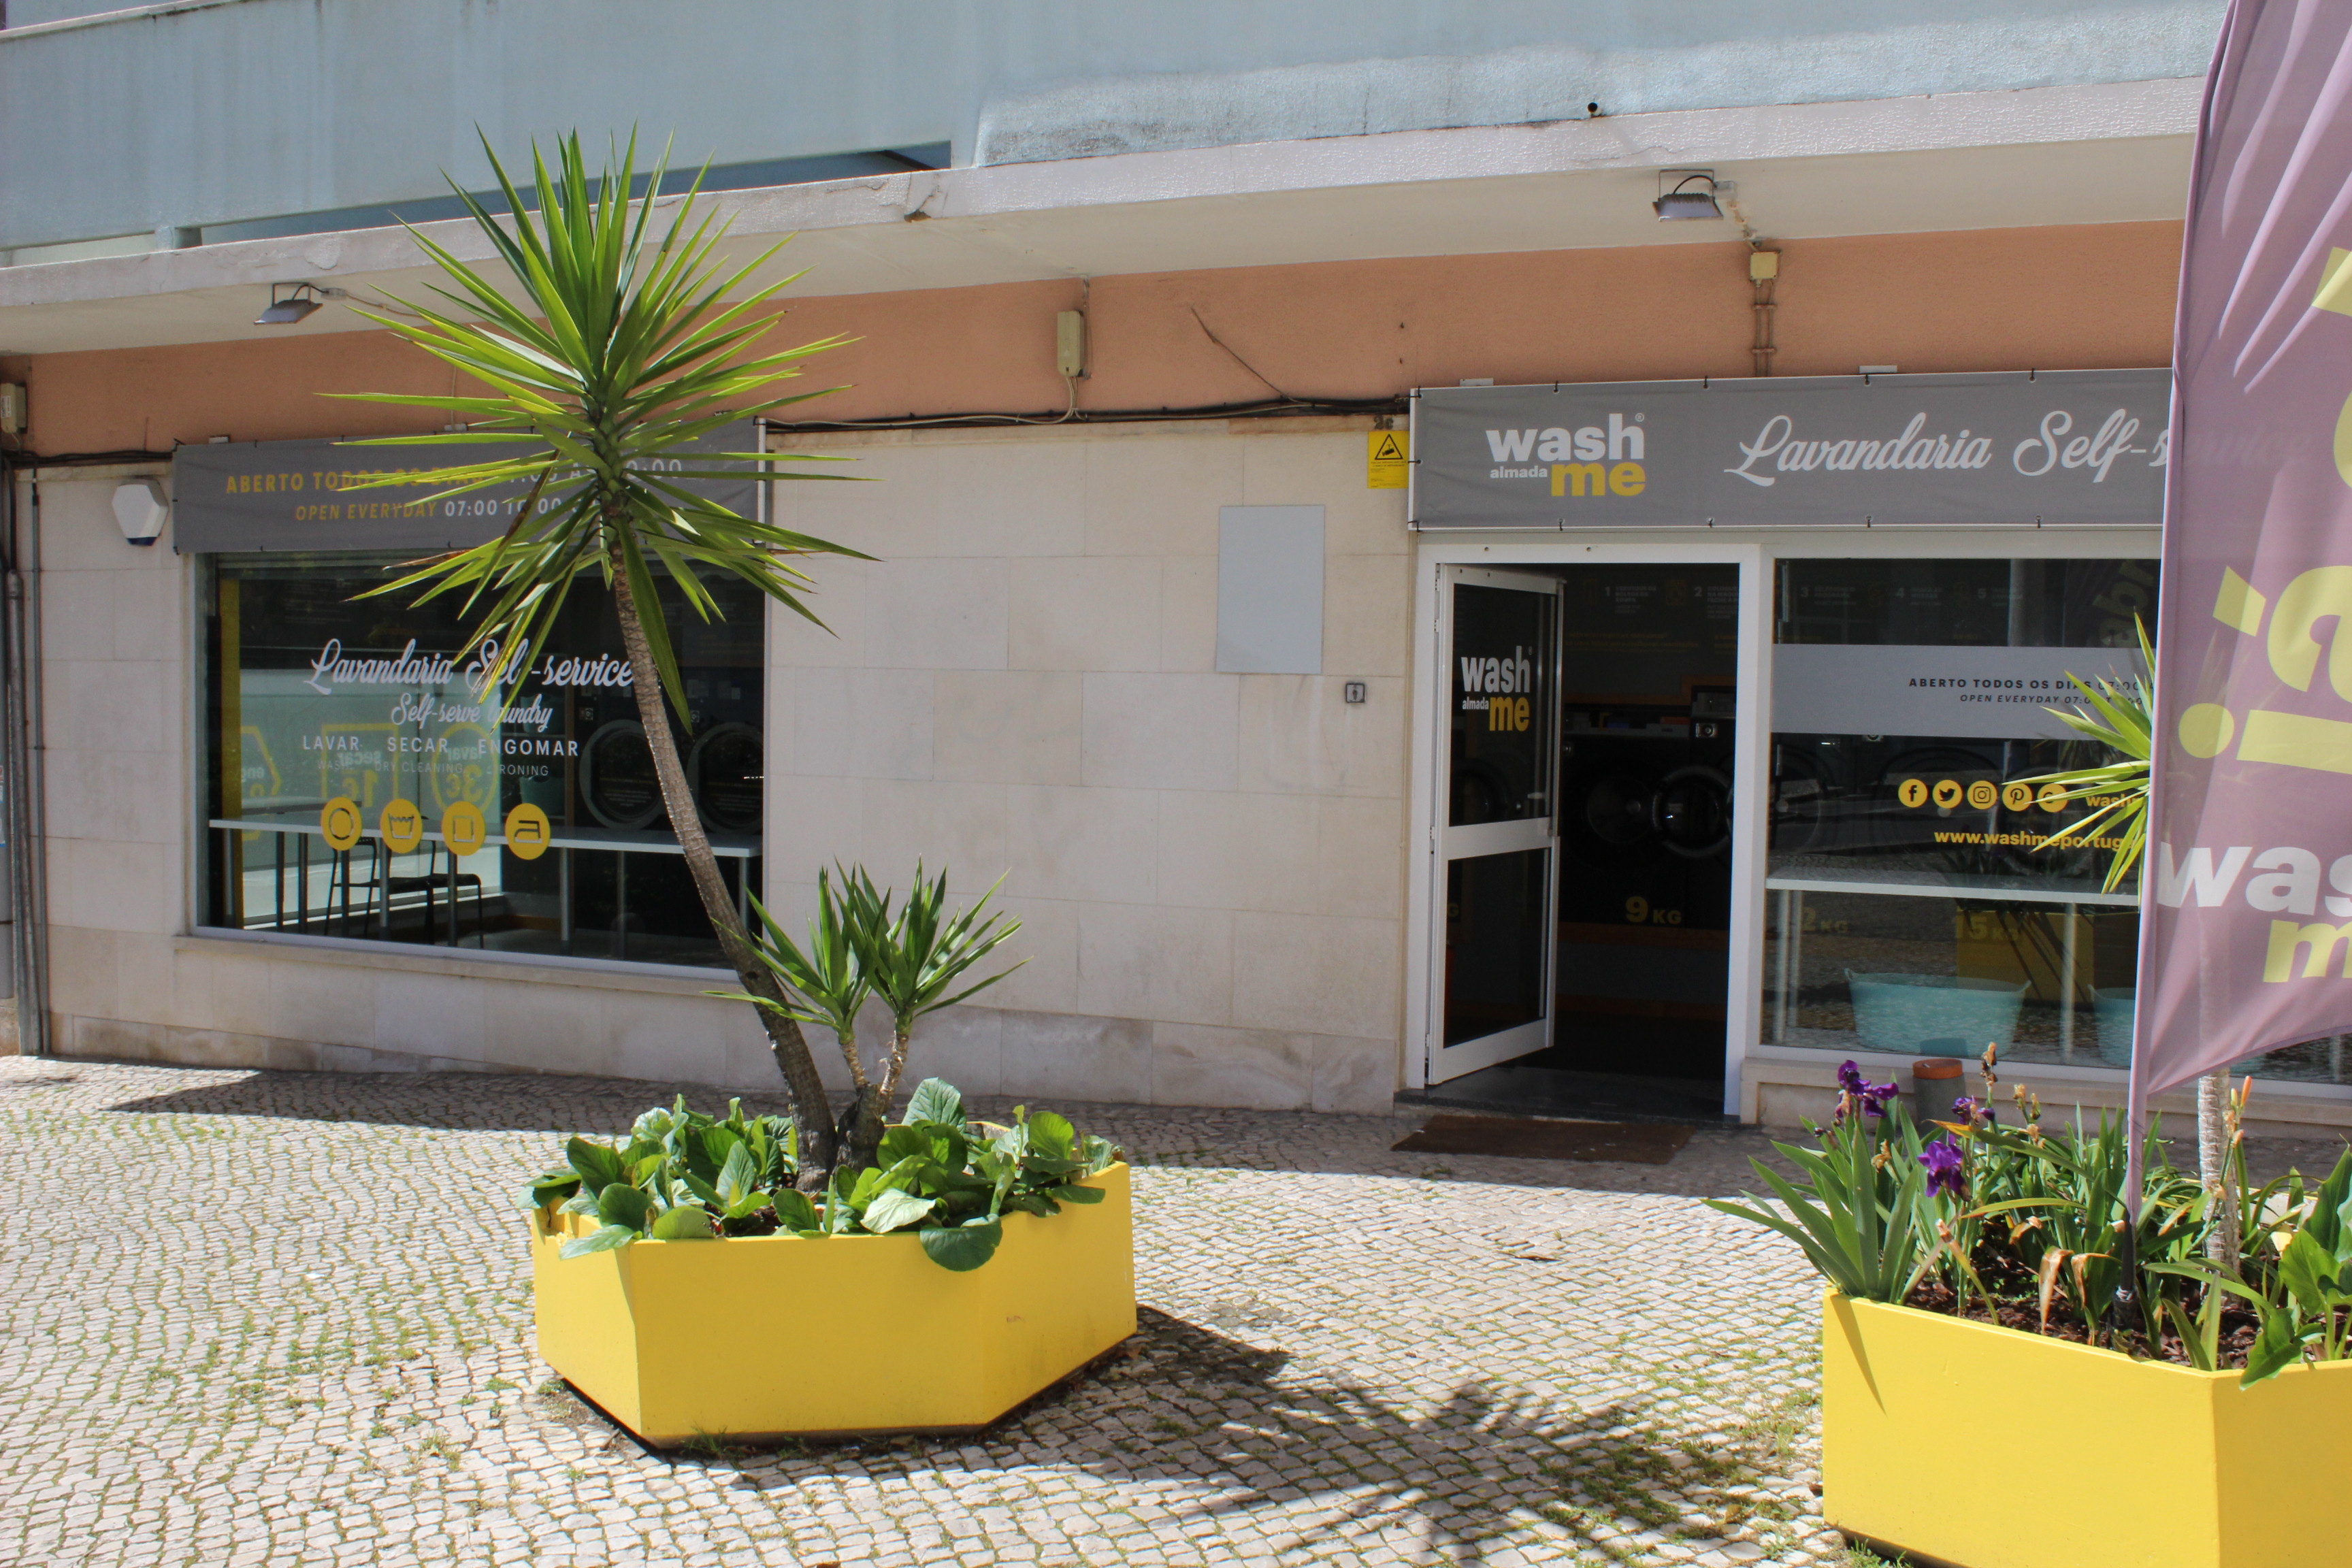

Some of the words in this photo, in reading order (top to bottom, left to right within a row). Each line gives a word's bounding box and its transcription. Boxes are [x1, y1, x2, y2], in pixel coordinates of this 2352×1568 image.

[1724, 412, 1993, 487] Lavandaria
[1490, 466, 1548, 478] almada
[1551, 462, 1646, 497] me
[227, 474, 304, 493] ABERTO
[296, 505, 340, 521] OPEN
[348, 502, 438, 519] EVERYDAY
[444, 500, 497, 517] 07:00
[304, 638, 455, 695] Lavandaria
[1909, 679, 1967, 688] ABERTO
[1973, 679, 2023, 689] TODOS
[2030, 681, 2049, 689] OS
[1463, 696, 1489, 710] almada
[1960, 694, 1992, 702] OPEN
[1997, 695, 2059, 704] EVERYDAY
[391, 693, 480, 730] Self-serve
[1489, 696, 1530, 732] me
[303, 735, 360, 751] LAVAR
[387, 736, 448, 753] SECAR
[478, 738, 578, 757] ENGOMAR
[1626, 896, 1648, 923] 9
[1653, 909, 1682, 925] KG
